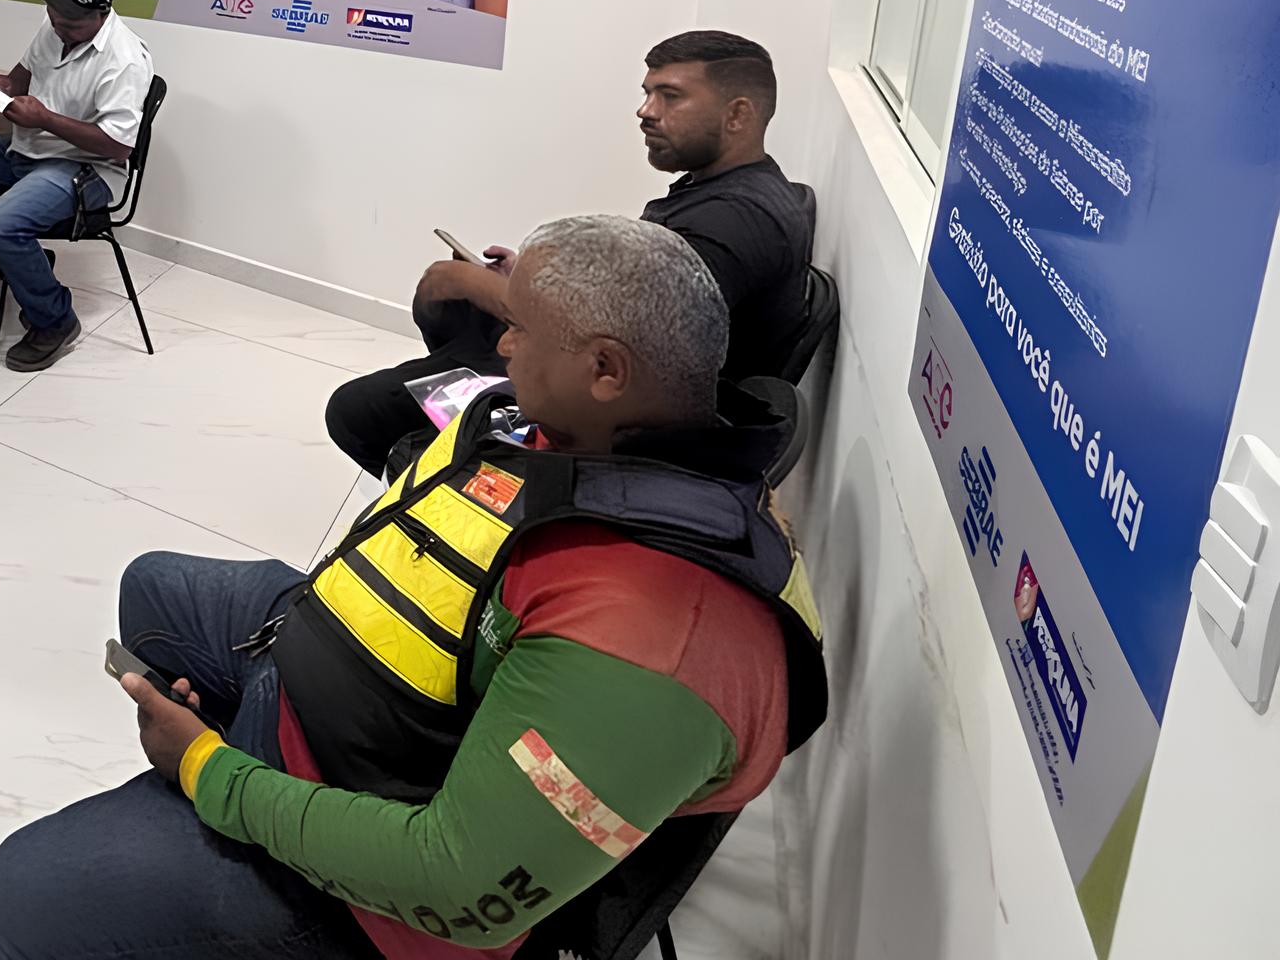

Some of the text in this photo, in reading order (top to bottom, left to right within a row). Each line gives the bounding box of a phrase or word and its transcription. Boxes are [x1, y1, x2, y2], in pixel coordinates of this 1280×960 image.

[1051, 380, 1083, 451] que
[1085, 430, 1101, 479] é
[1100, 450, 1144, 552] MEI
